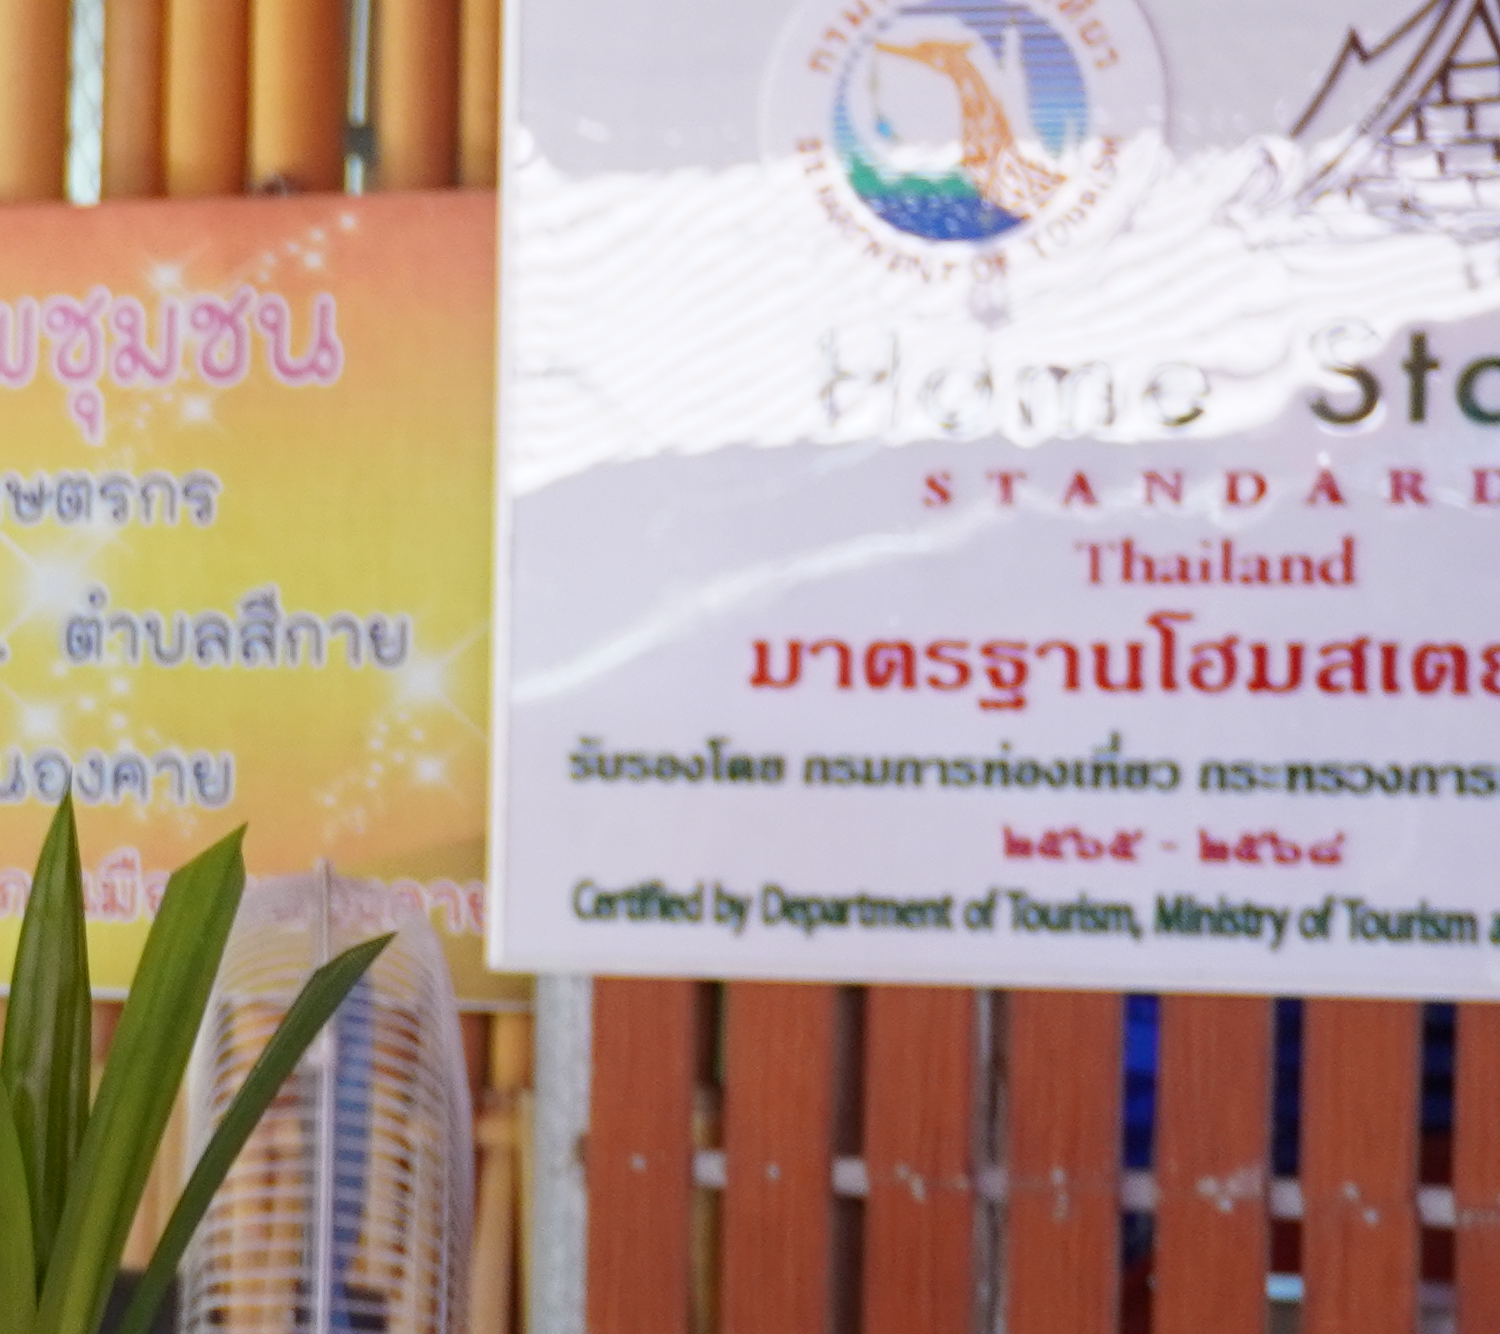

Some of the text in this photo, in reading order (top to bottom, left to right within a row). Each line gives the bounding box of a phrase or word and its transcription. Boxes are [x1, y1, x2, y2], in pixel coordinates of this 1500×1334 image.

[1077, 536, 1359, 589] Thailand
[572, 879, 704, 922] Certified
[713, 882, 750, 935] by
[762, 883, 953, 937] Department
[964, 889, 999, 927] of
[1155, 895, 1288, 951] Ministry
[1299, 893, 1338, 940] of
[1343, 897, 1478, 943] Tourism
